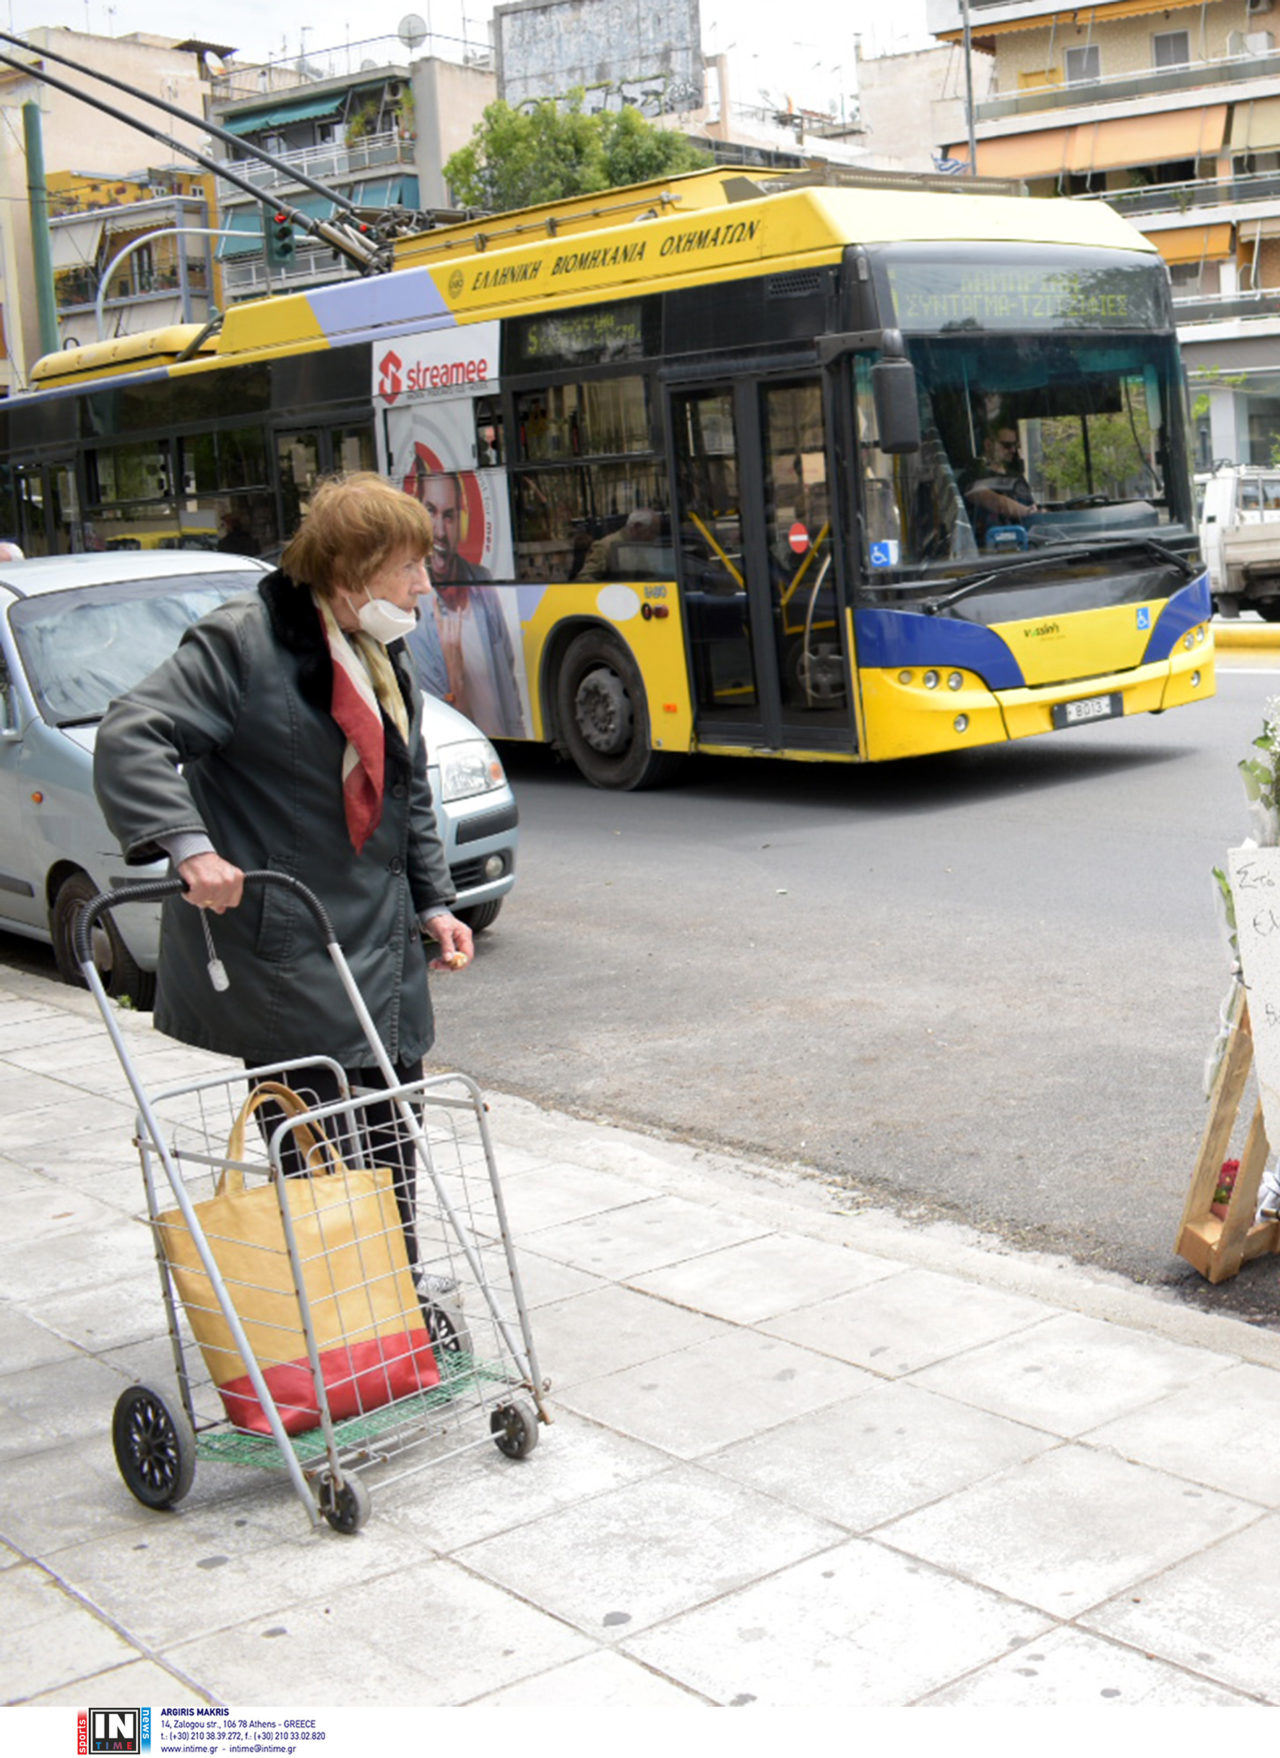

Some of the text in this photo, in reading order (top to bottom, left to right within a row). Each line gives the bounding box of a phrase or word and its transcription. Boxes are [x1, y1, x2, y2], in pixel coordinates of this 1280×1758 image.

[471, 261, 542, 291] ΕΛΛΗΝΙΚΗ
[551, 241, 647, 276] ΒΙΟΜΗΧΑΝΙΑ
[659, 220, 760, 257] ΟΧΗΜΑΤΩΝ
[407, 358, 487, 390] streamee
